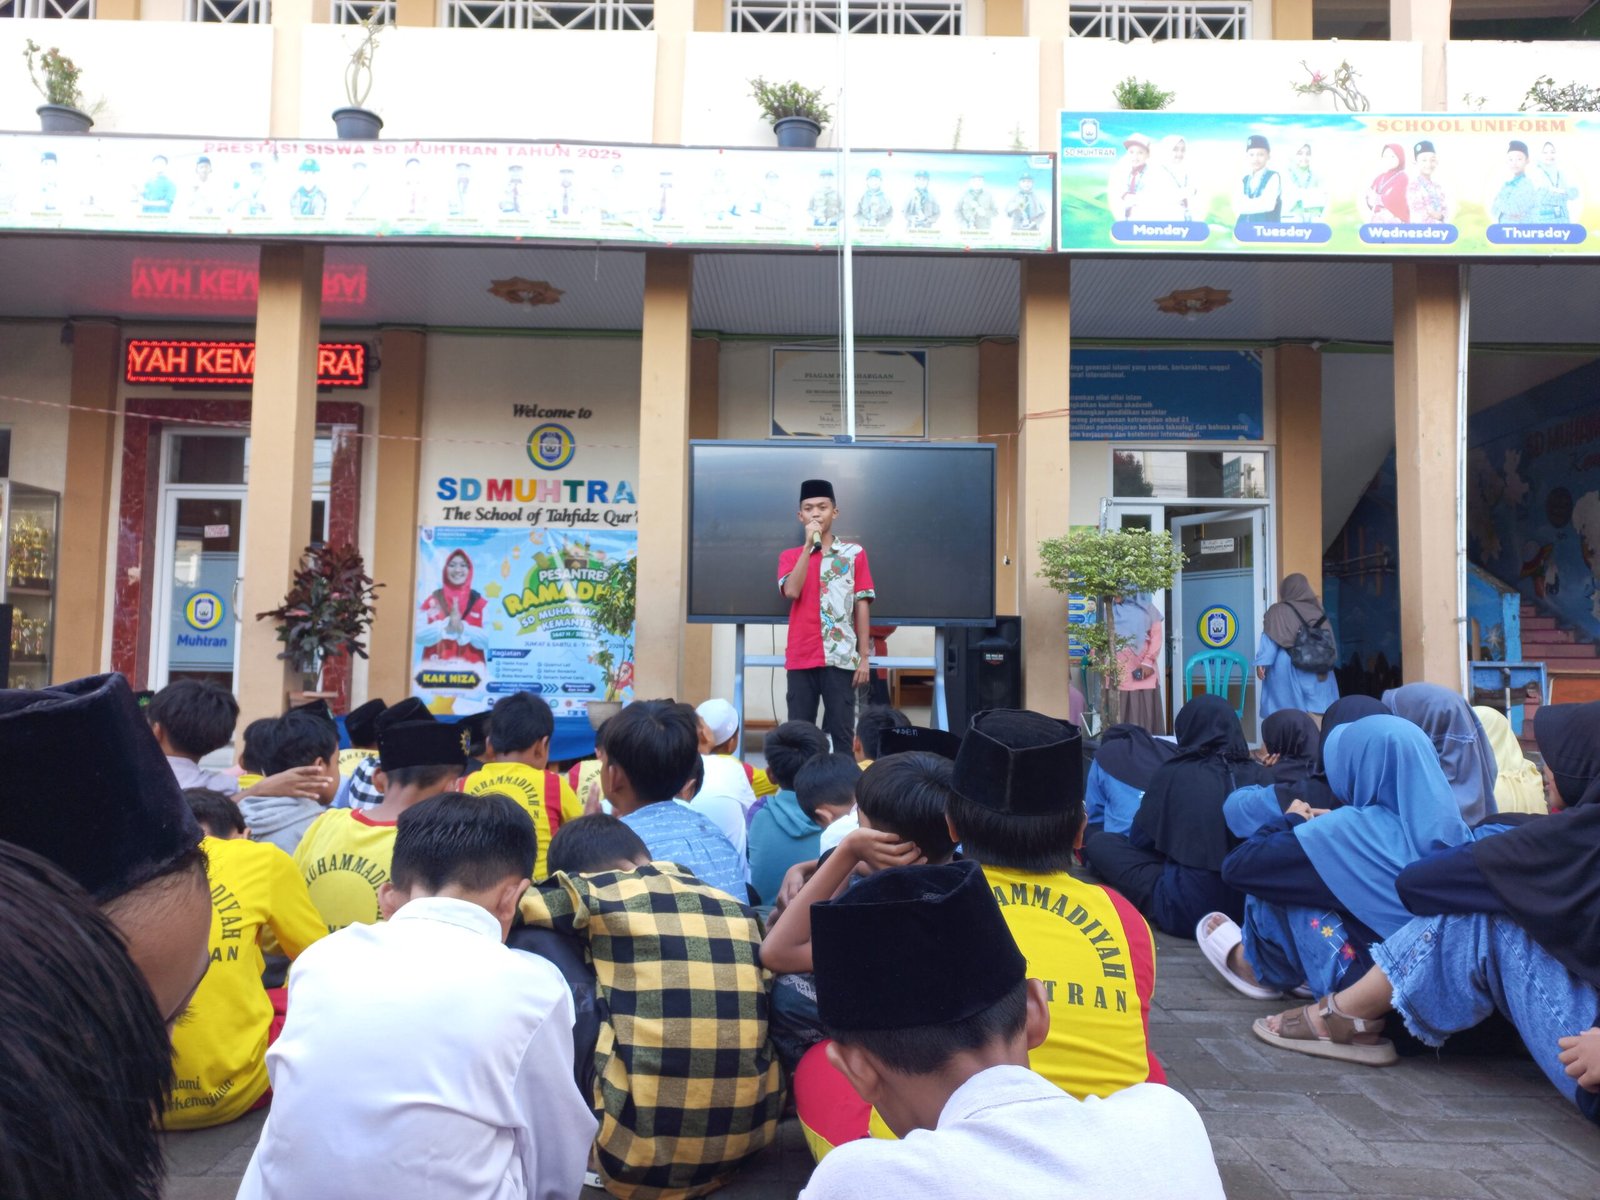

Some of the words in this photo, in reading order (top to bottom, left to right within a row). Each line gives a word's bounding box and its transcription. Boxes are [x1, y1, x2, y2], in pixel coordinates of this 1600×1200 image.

[1376, 119, 1464, 132] SCHOOL
[1470, 119, 1567, 132] UNIFORM
[203, 141, 298, 154] PRESTASI
[304, 143, 365, 154] SISWA
[373, 144, 396, 154] SD
[404, 144, 497, 156] MUHTRAN
[505, 146, 570, 158] TAHUN
[577, 148, 622, 159] 2025
[1132, 224, 1189, 238] Monday
[1253, 225, 1313, 239] Tuesday
[1368, 227, 1449, 240] Wednesday
[1502, 227, 1571, 240] Thursday
[131, 346, 188, 373] YAH
[513, 403, 576, 418] Welcome
[577, 407, 593, 419] to
[436, 477, 482, 501] SD
[486, 478, 637, 504] MUHTRA
[443, 506, 471, 521] The
[475, 507, 523, 521] School
[527, 507, 543, 526] of
[546, 508, 599, 527] Tahfidz
[603, 508, 638, 527] Qur'
[176, 634, 227, 647] Muhtran
[993, 882, 1127, 981] AMMADIYAH
